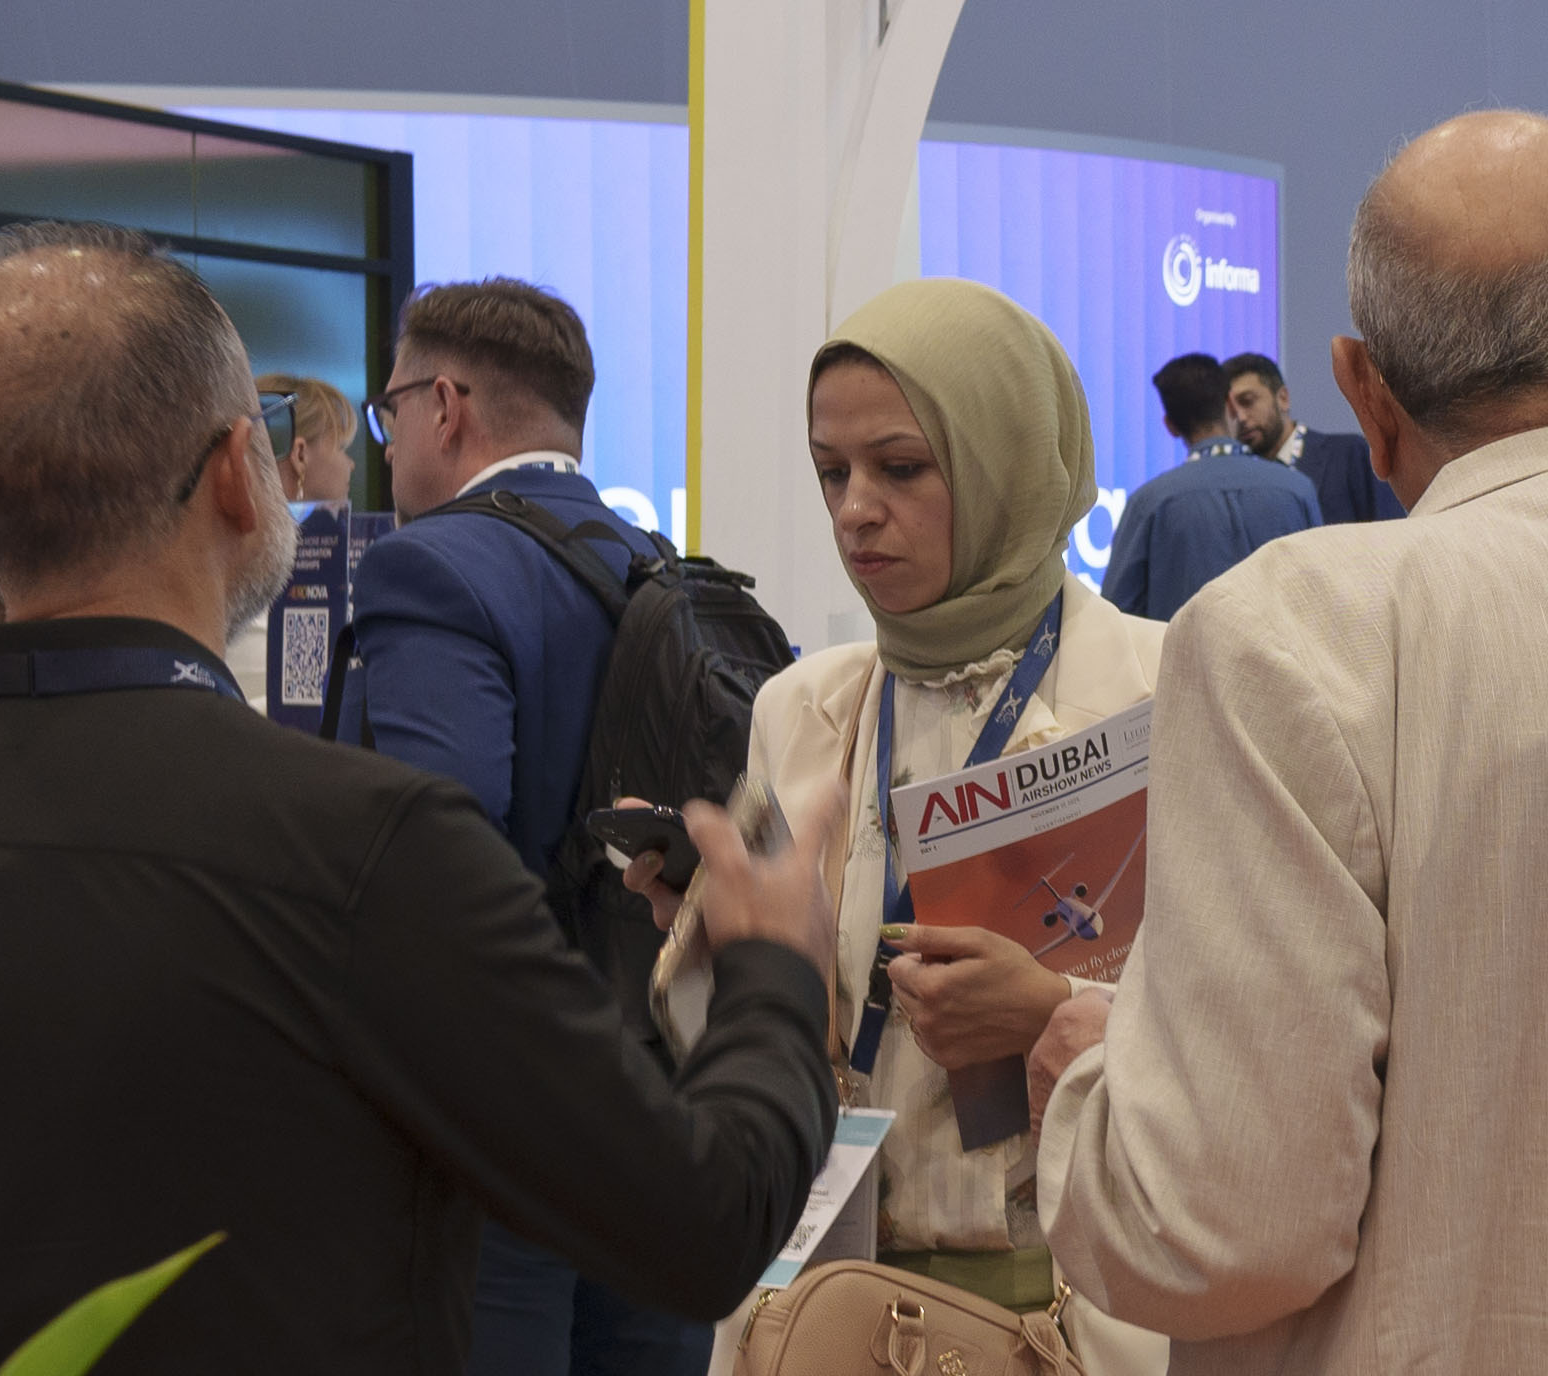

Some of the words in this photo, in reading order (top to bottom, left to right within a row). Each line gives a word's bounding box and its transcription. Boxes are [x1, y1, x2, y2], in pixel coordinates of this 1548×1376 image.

[1205, 257, 1260, 294] informa
[1015, 732, 1109, 791] DUBAI
[1021, 776, 1077, 805] AIRSHOW
[1080, 759, 1112, 782] NEWS
[918, 771, 1012, 836] AIN
